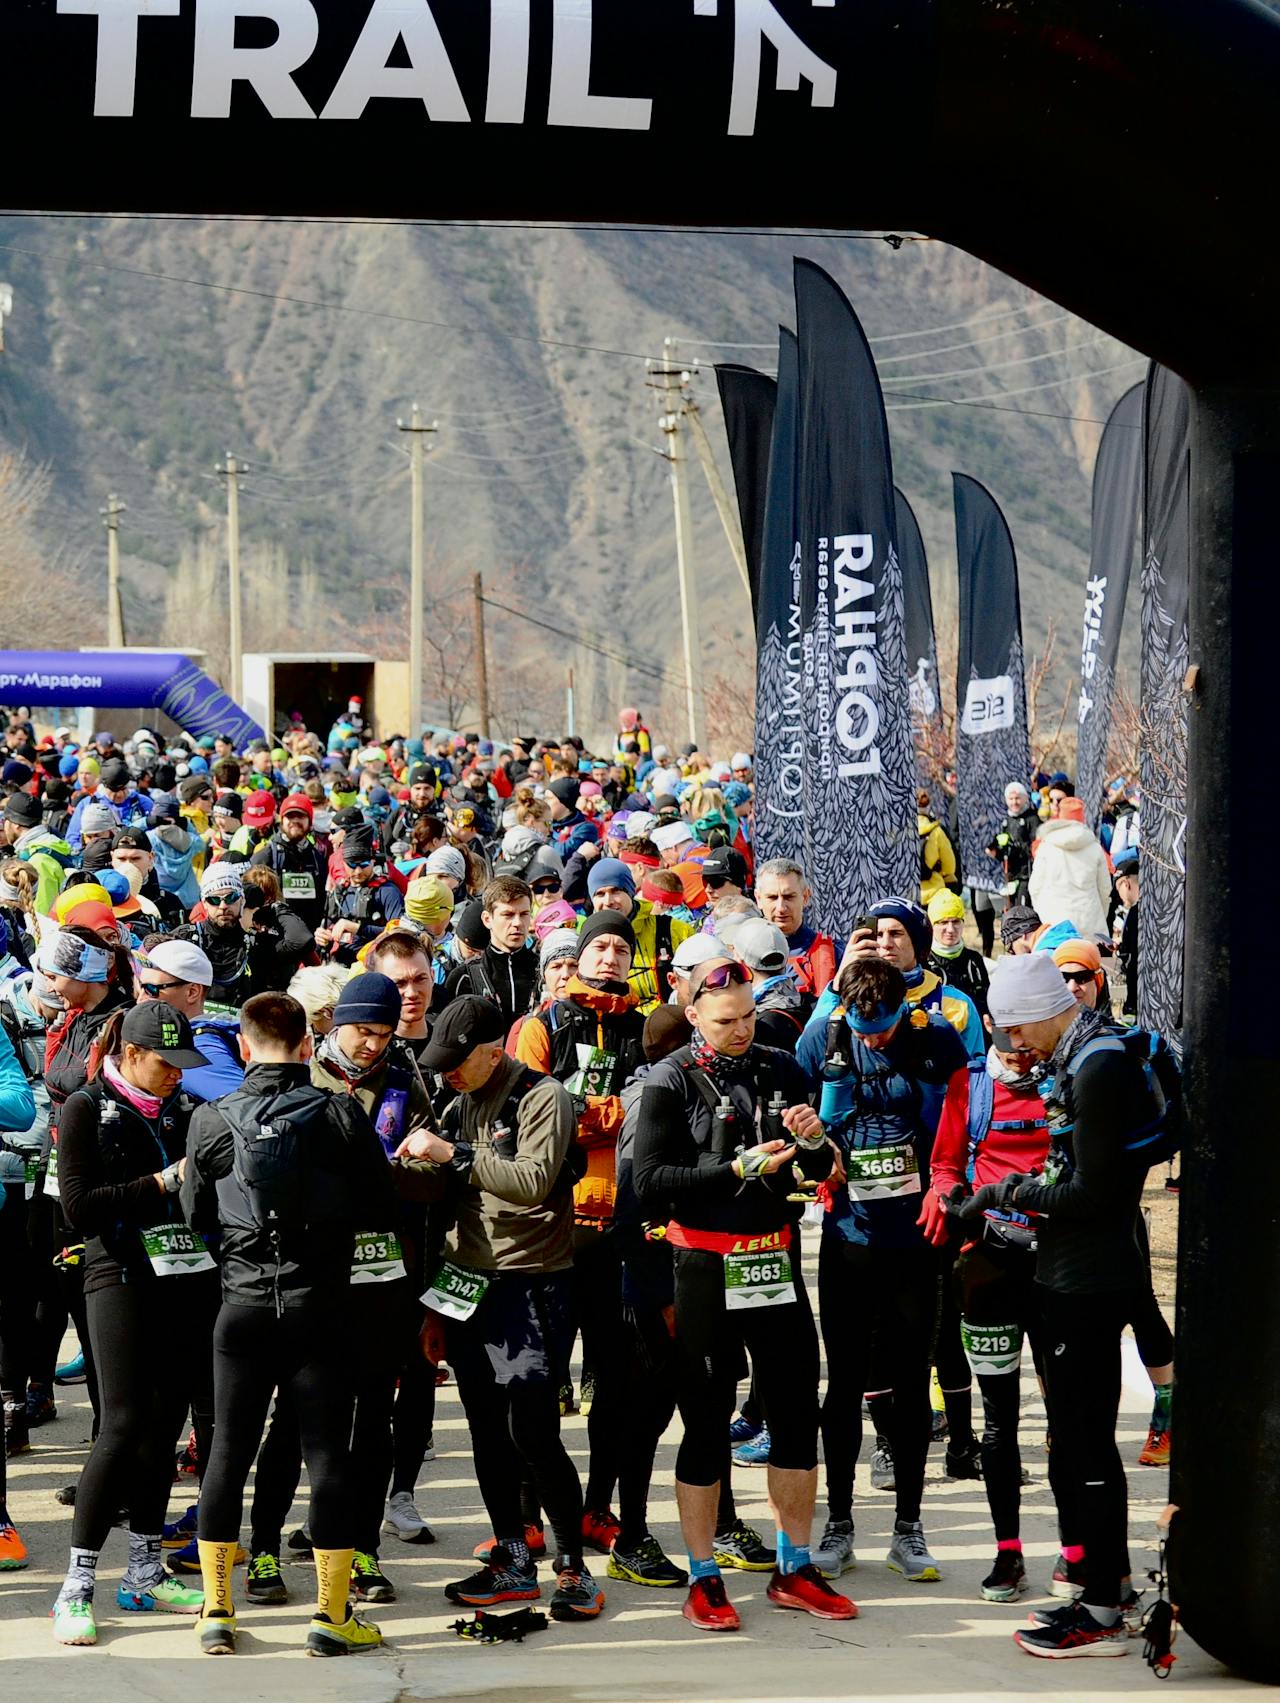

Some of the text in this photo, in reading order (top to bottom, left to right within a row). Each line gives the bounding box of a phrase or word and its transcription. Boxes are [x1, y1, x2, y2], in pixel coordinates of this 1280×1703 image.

[23, 0, 653, 130] TRAIL
[859, 1156, 906, 1177] 3668
[158, 1234, 194, 1251] 3435
[731, 1231, 780, 1253] LEKI
[740, 1263, 781, 1284] 3663
[446, 1275, 480, 1298] 3147
[970, 1335, 1011, 1352] 3219
